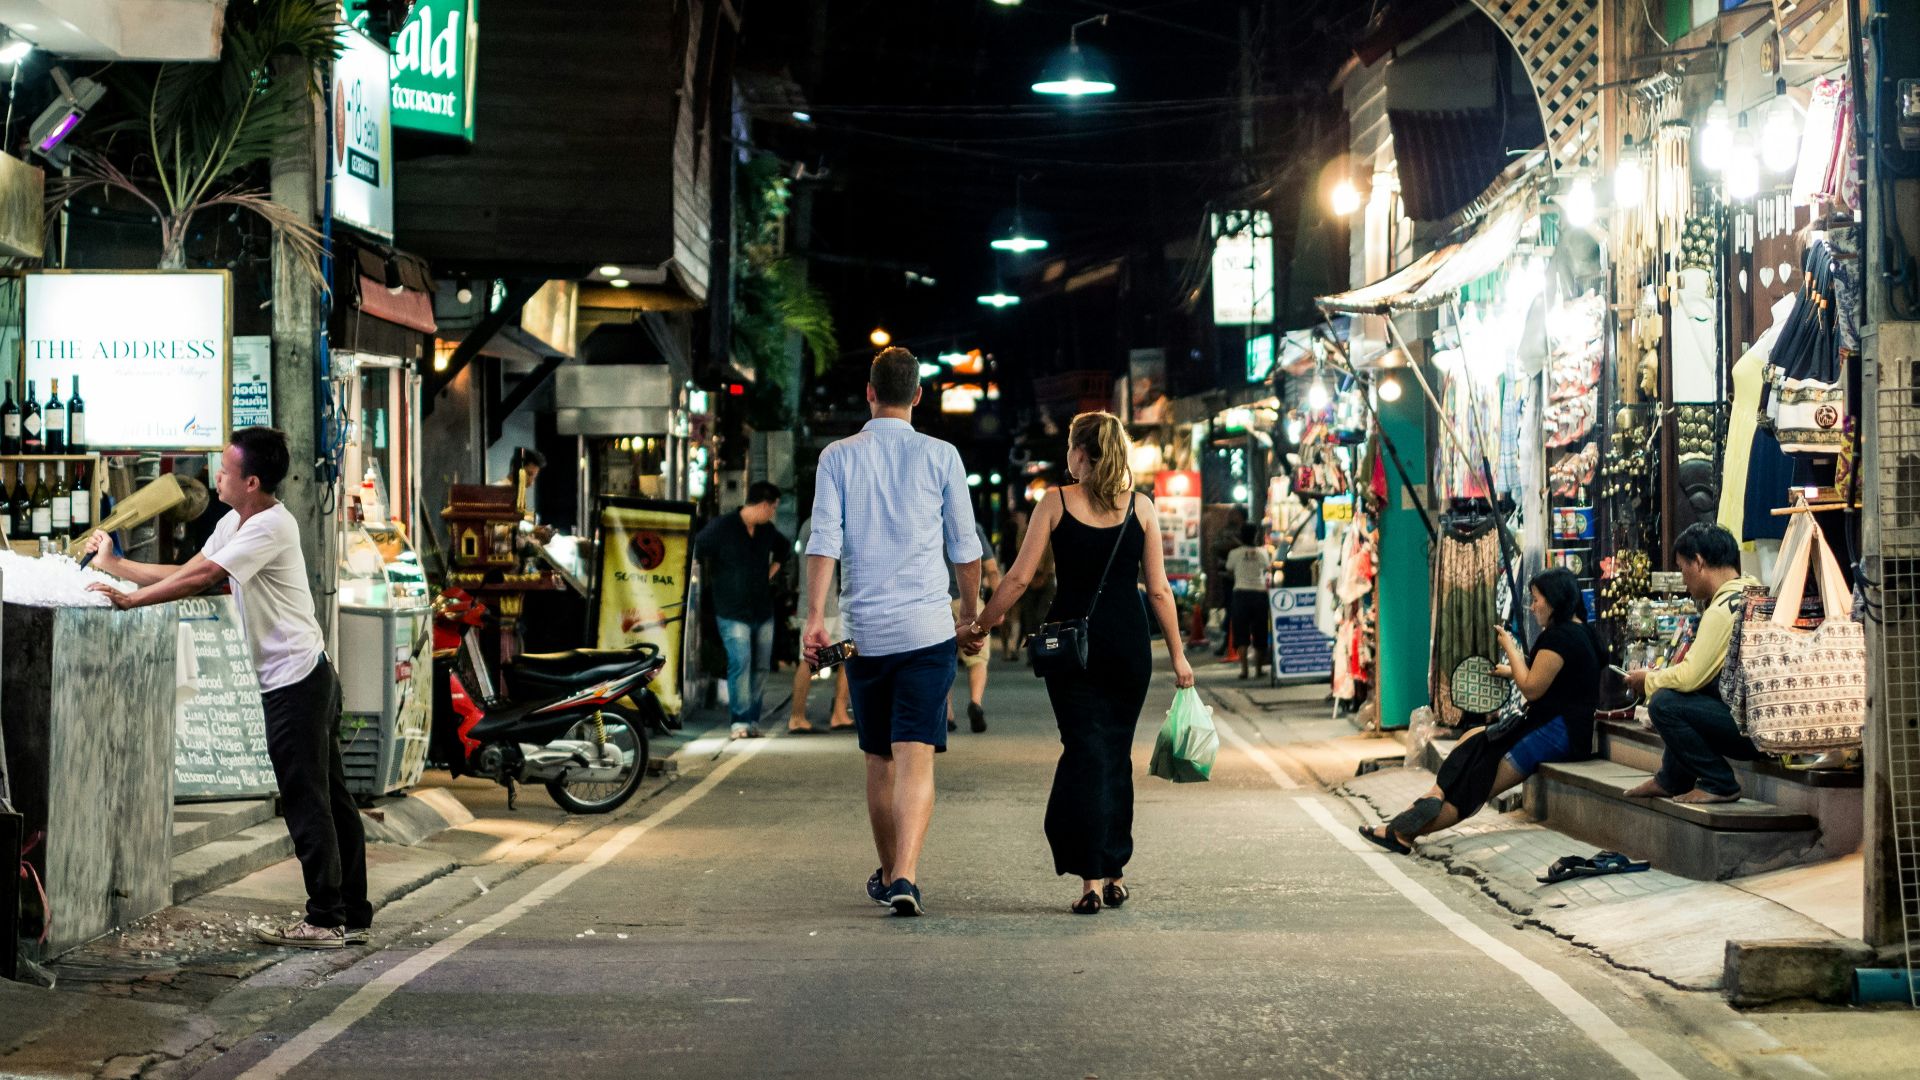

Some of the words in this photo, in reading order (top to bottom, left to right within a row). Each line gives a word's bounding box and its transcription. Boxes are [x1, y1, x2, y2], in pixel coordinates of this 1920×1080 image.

[31, 340, 82, 359] THE
[92, 339, 216, 360] ADDRESS
[652, 574, 675, 586] BAR
[208, 707, 241, 722] Chicken
[211, 722, 243, 737] Chicken
